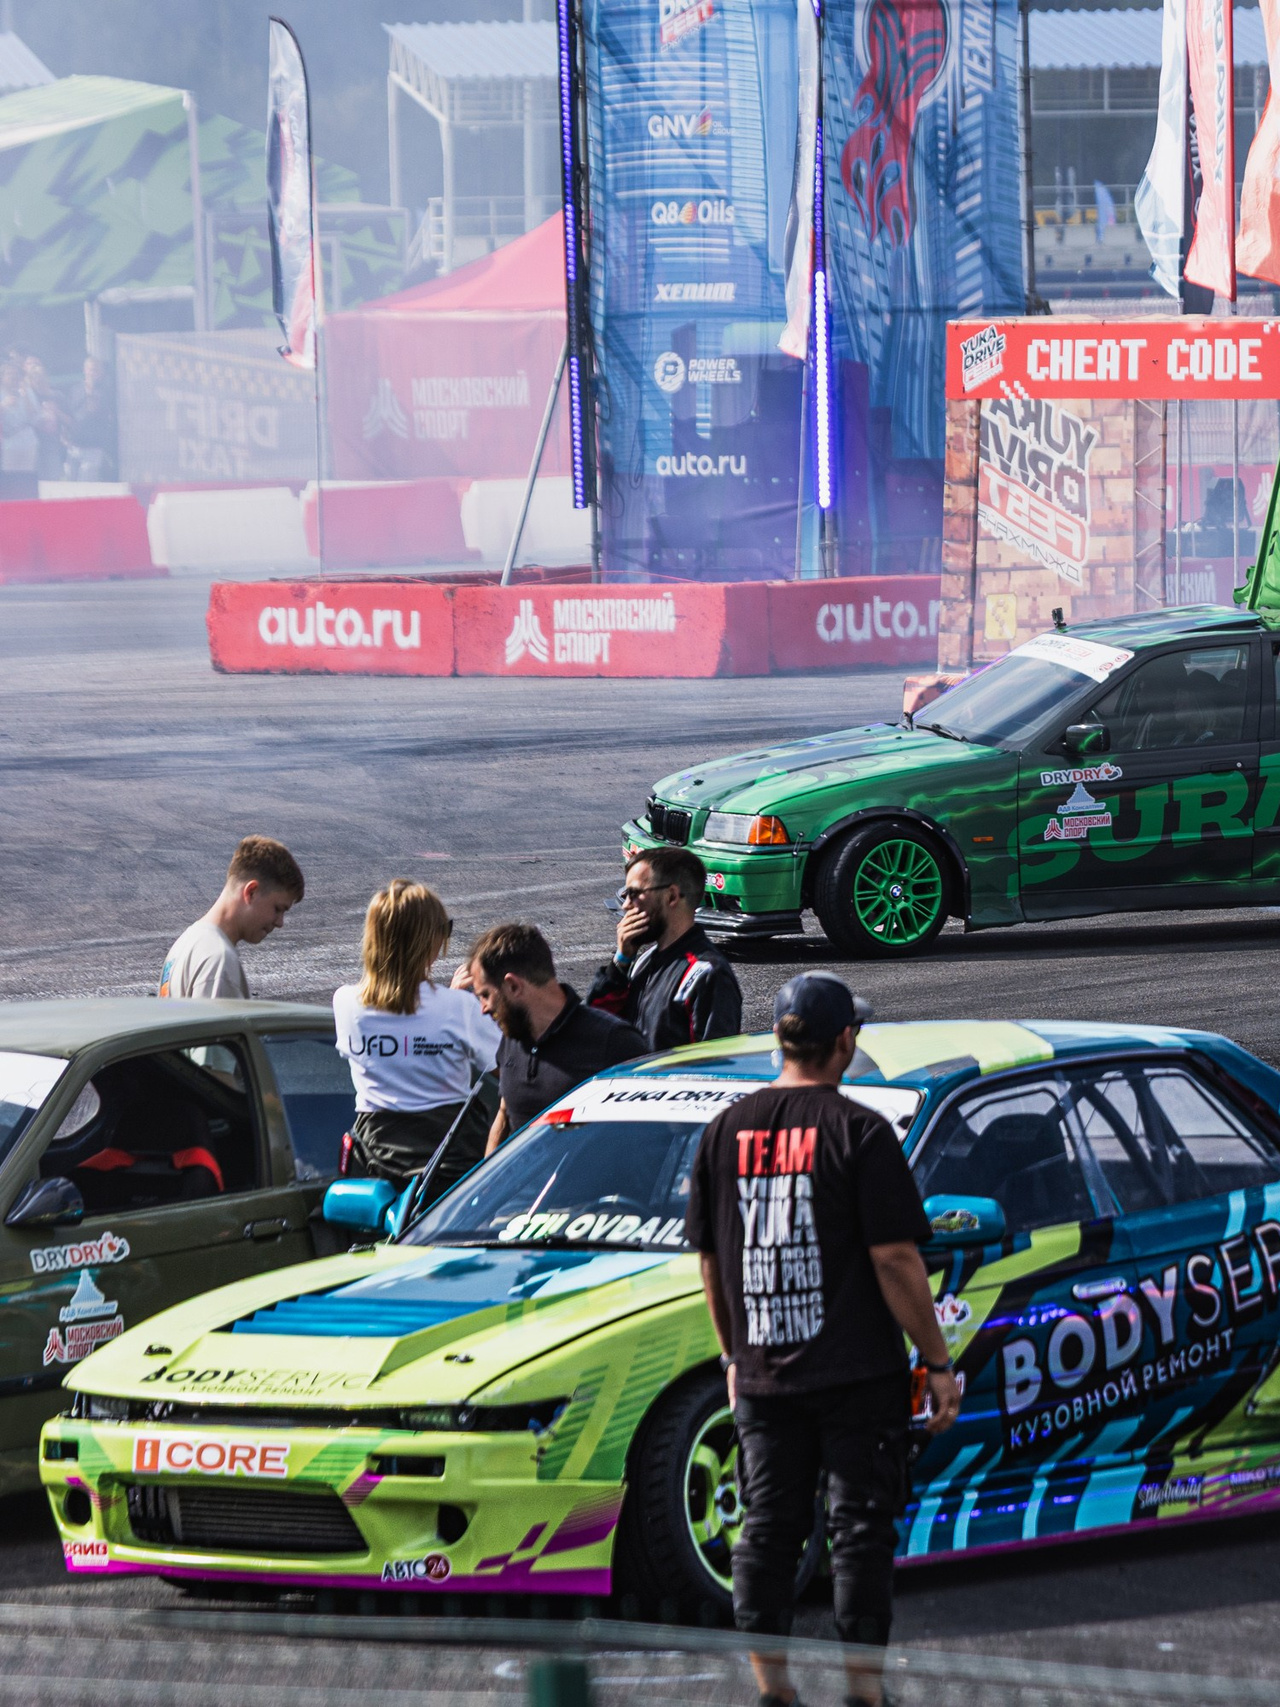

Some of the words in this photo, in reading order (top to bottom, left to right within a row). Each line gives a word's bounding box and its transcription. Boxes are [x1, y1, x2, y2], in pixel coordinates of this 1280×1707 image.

[648, 114, 698, 138] GNV
[651, 202, 680, 225] Q8
[698, 200, 735, 224] Oils
[962, 326, 997, 355] YUKA
[964, 336, 1004, 370] DRIVE
[689, 359, 736, 371] POWER
[1027, 338, 1147, 382] CHEAT
[1167, 338, 1262, 382] CODE
[412, 369, 531, 409] МОСКОВСКИЙ
[688, 370, 741, 382] WHEELS
[413, 410, 470, 440] СПОРТ
[656, 452, 747, 476] auto.ru
[258, 601, 420, 649] auto.ru
[553, 592, 677, 632] МОСКОВСКИЙ
[816, 595, 940, 643] auto.r
[554, 632, 611, 664] СПОРТ
[1042, 768, 1101, 785] DRYDRY
[1064, 813, 1110, 827] МОСКОВСКИЙ
[1064, 827, 1086, 838] СПОРТ
[601, 1090, 669, 1103] YUKA
[736, 1127, 818, 1177] TEAM
[738, 1196, 819, 1248] YUKA
[33, 1243, 104, 1271] DRYDRY
[782, 1256, 823, 1292] PRO
[68, 1317, 123, 1341] МОСКОВСКИЙ
[746, 1302, 825, 1346] RACING
[1010, 1366, 1138, 1448] КУЗОВНОЙ
[1143, 1328, 1235, 1391] РЕМОНТ
[166, 1442, 287, 1474] CORE
